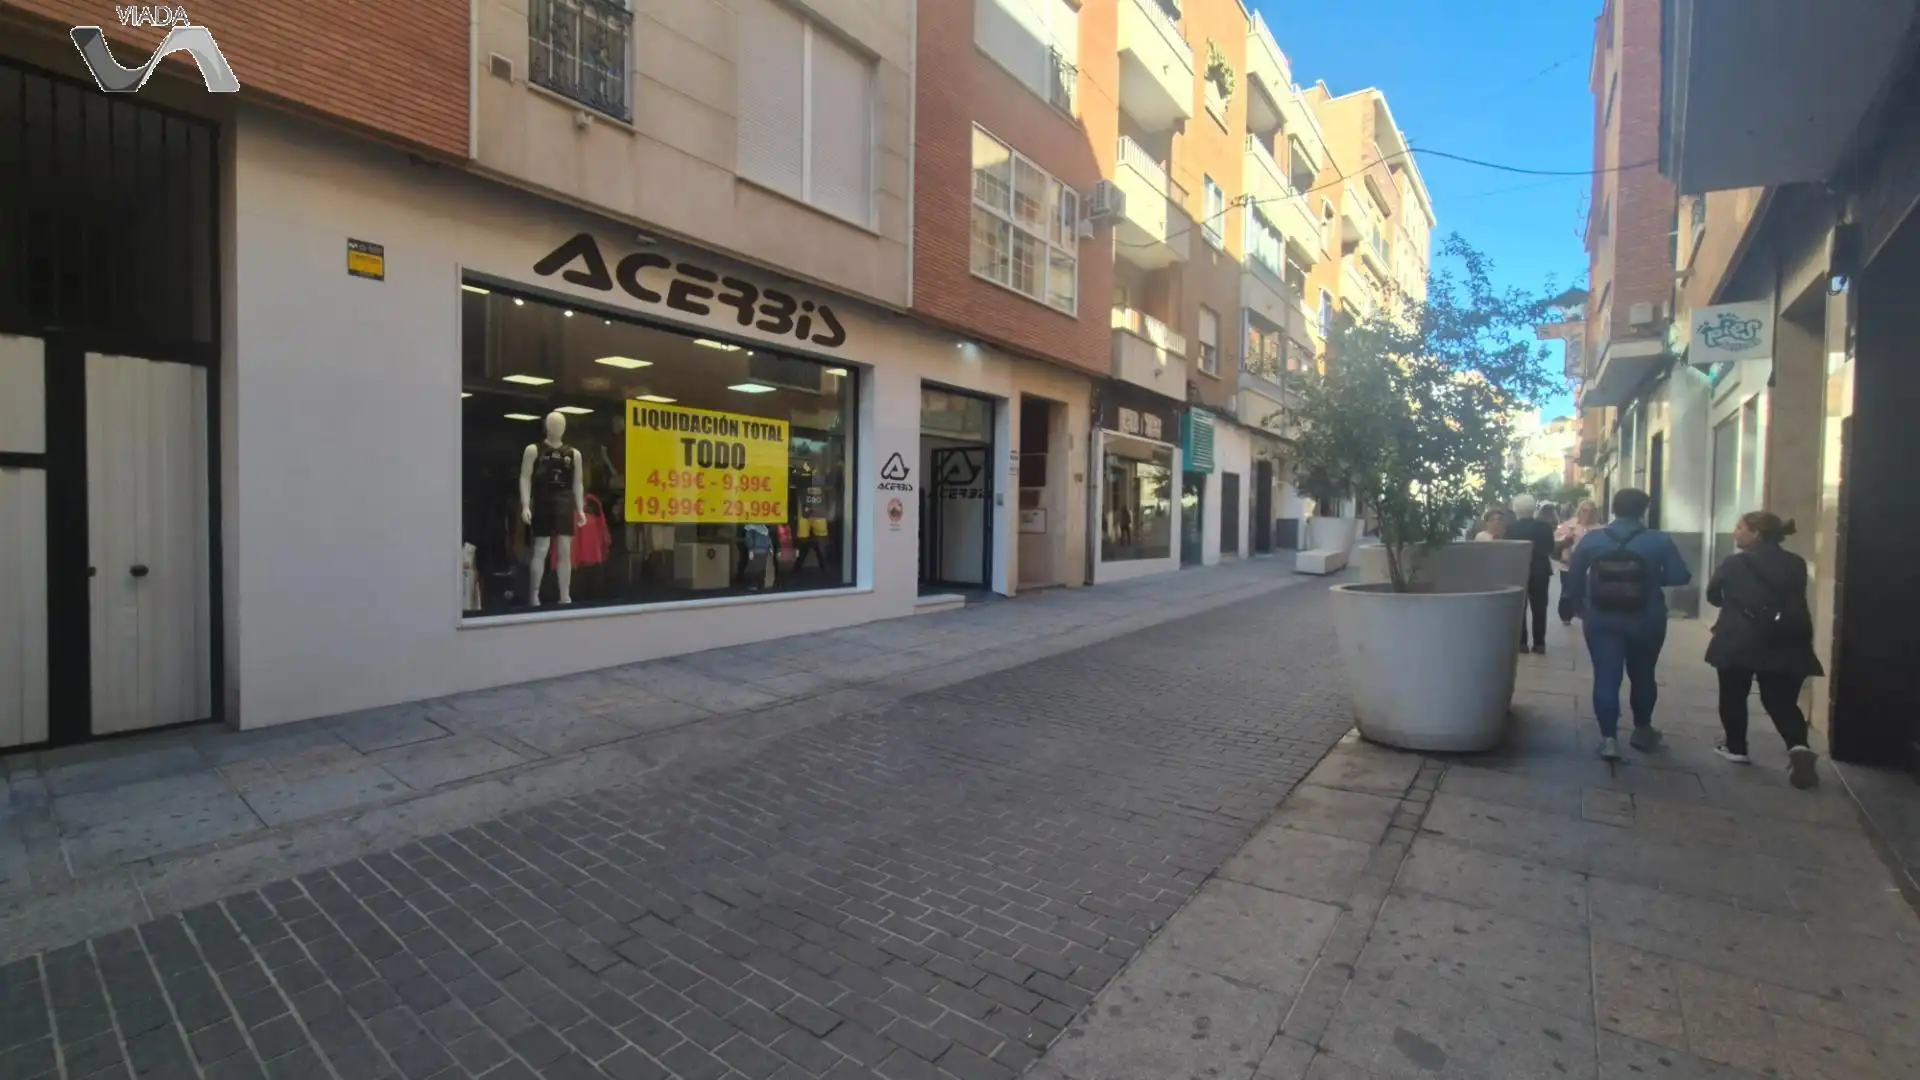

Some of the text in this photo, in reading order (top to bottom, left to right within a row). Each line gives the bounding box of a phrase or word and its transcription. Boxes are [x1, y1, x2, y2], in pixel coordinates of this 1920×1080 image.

[632, 406, 784, 442] LIQUIDACIÓN TOTAL
[680, 437, 746, 471] TODO
[646, 469, 705, 493] 4,99€
[721, 474, 772, 494] 9,99€
[634, 496, 705, 519] 19,99€
